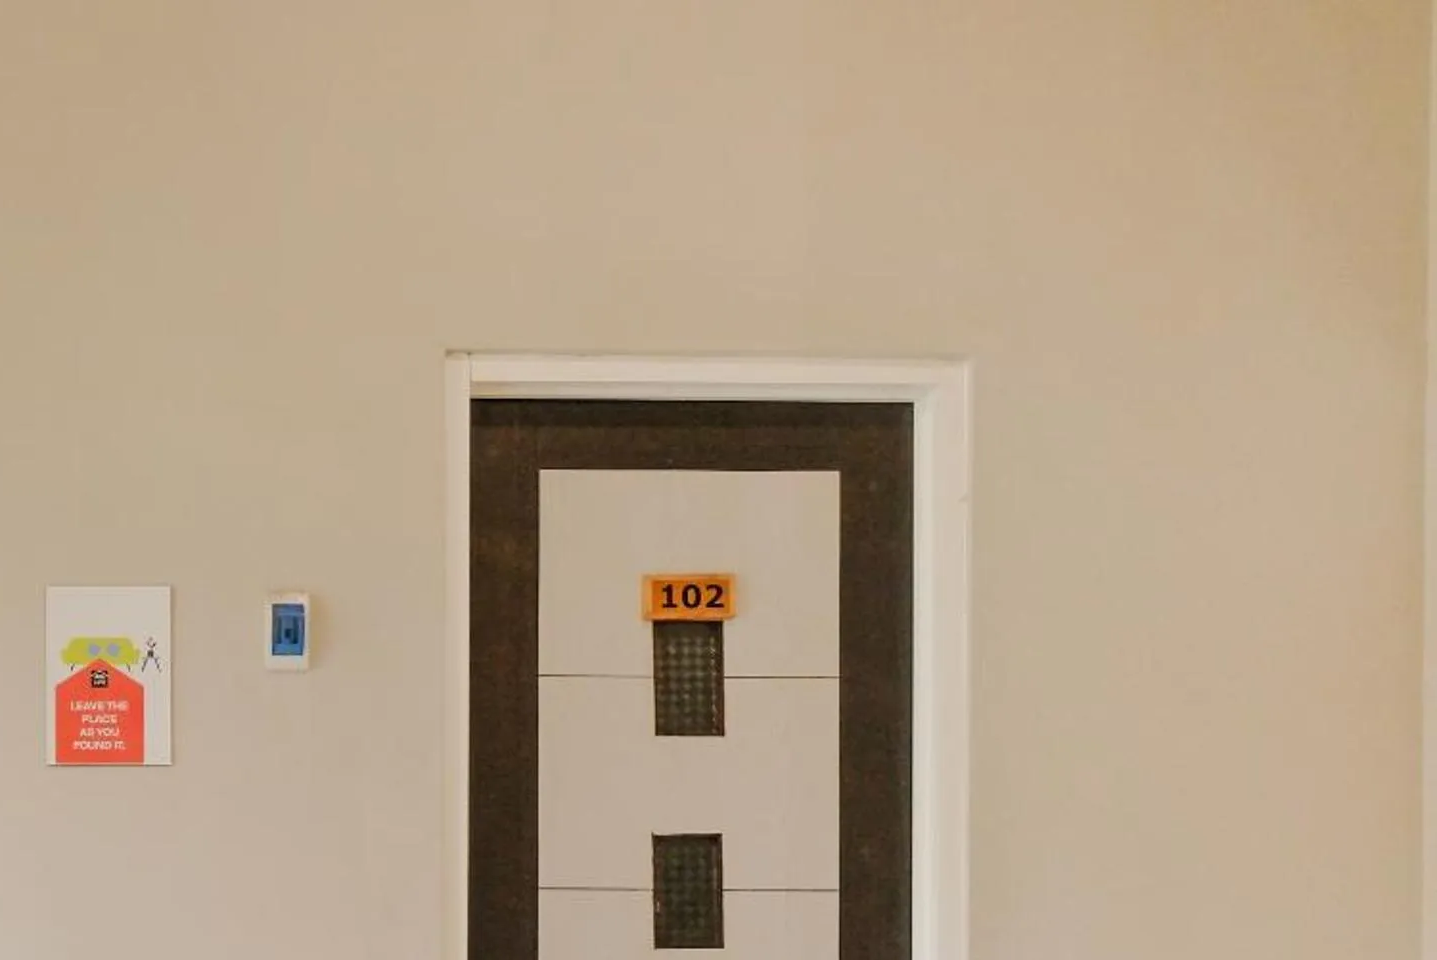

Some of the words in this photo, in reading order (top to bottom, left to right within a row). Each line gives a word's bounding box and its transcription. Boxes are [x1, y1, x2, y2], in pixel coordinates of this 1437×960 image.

[662, 583, 725, 609] 102
[70, 700, 104, 711] LEAVE
[107, 700, 129, 711] THE
[82, 714, 118, 724] PLACE
[80, 727, 95, 737] AS
[97, 727, 120, 737] YOU
[73, 740, 112, 751] FOUND
